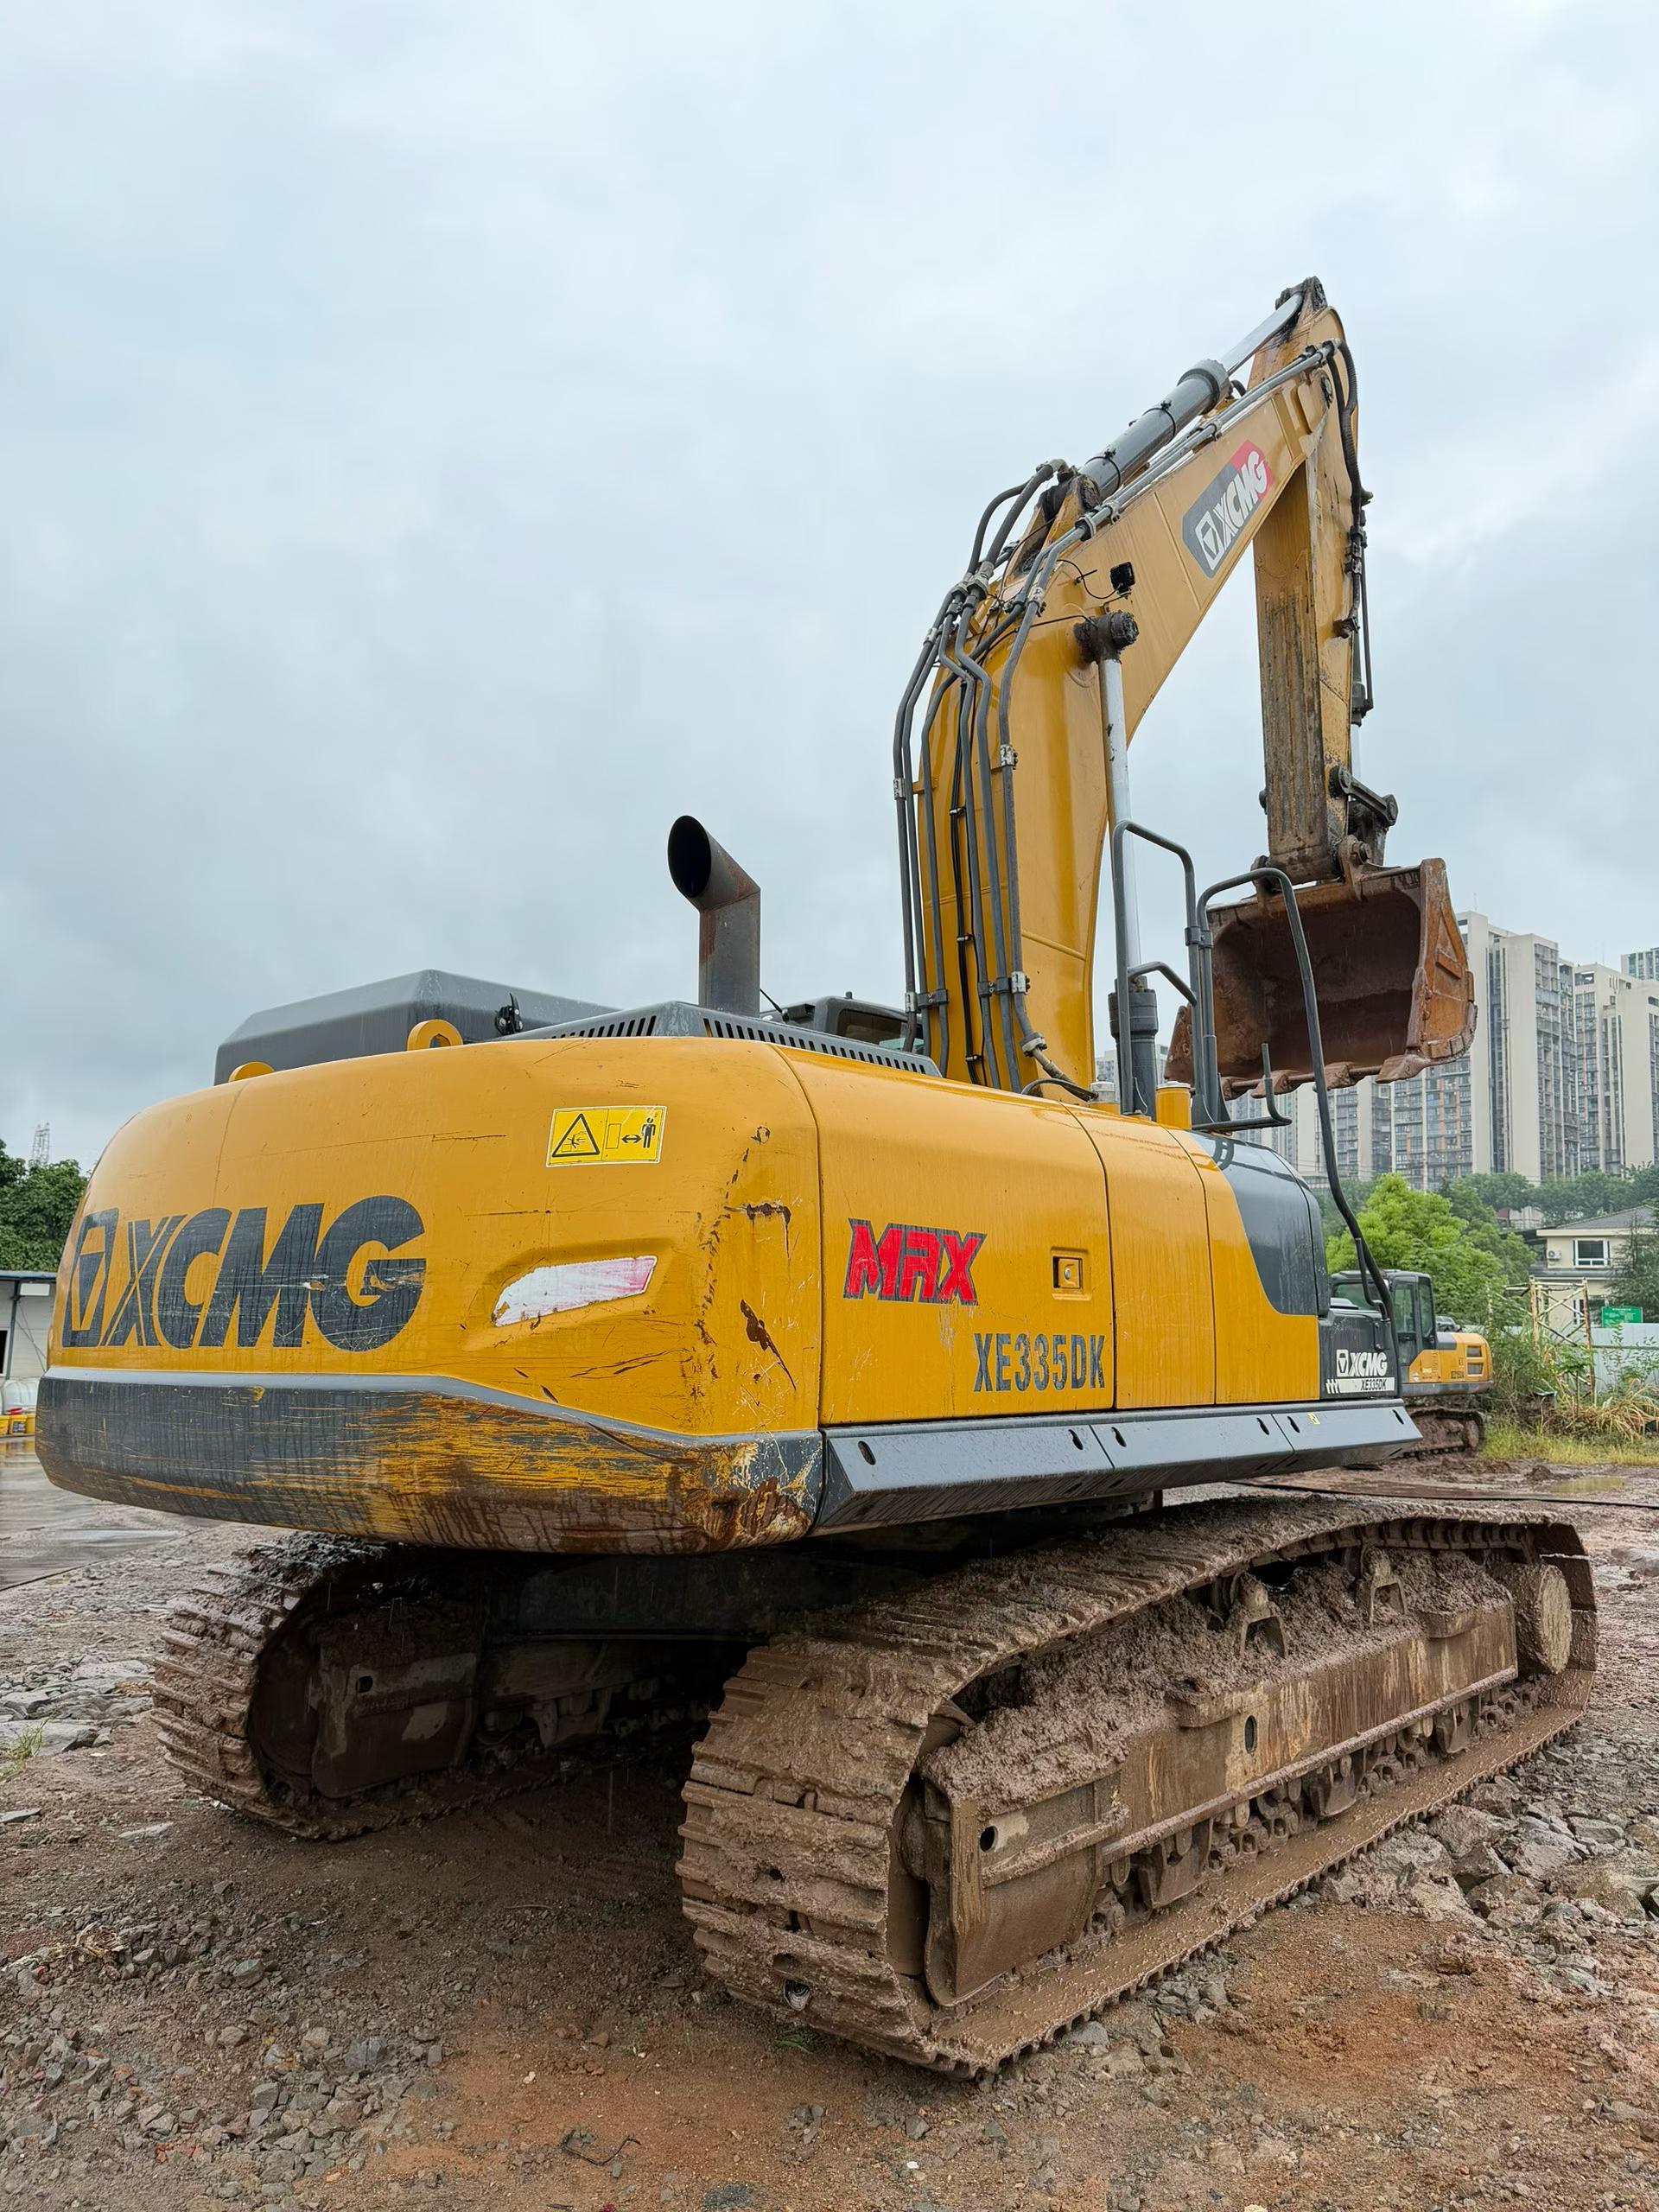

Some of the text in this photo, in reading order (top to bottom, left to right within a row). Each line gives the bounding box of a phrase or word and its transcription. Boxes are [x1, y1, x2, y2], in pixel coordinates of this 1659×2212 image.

[1213, 451, 1267, 550] XCMG
[99, 1195, 426, 1351] XCMG
[843, 1218, 987, 1306] MAX
[973, 1333, 1105, 1392] XE335DK
[1348, 1351, 1388, 1376] XCMG
